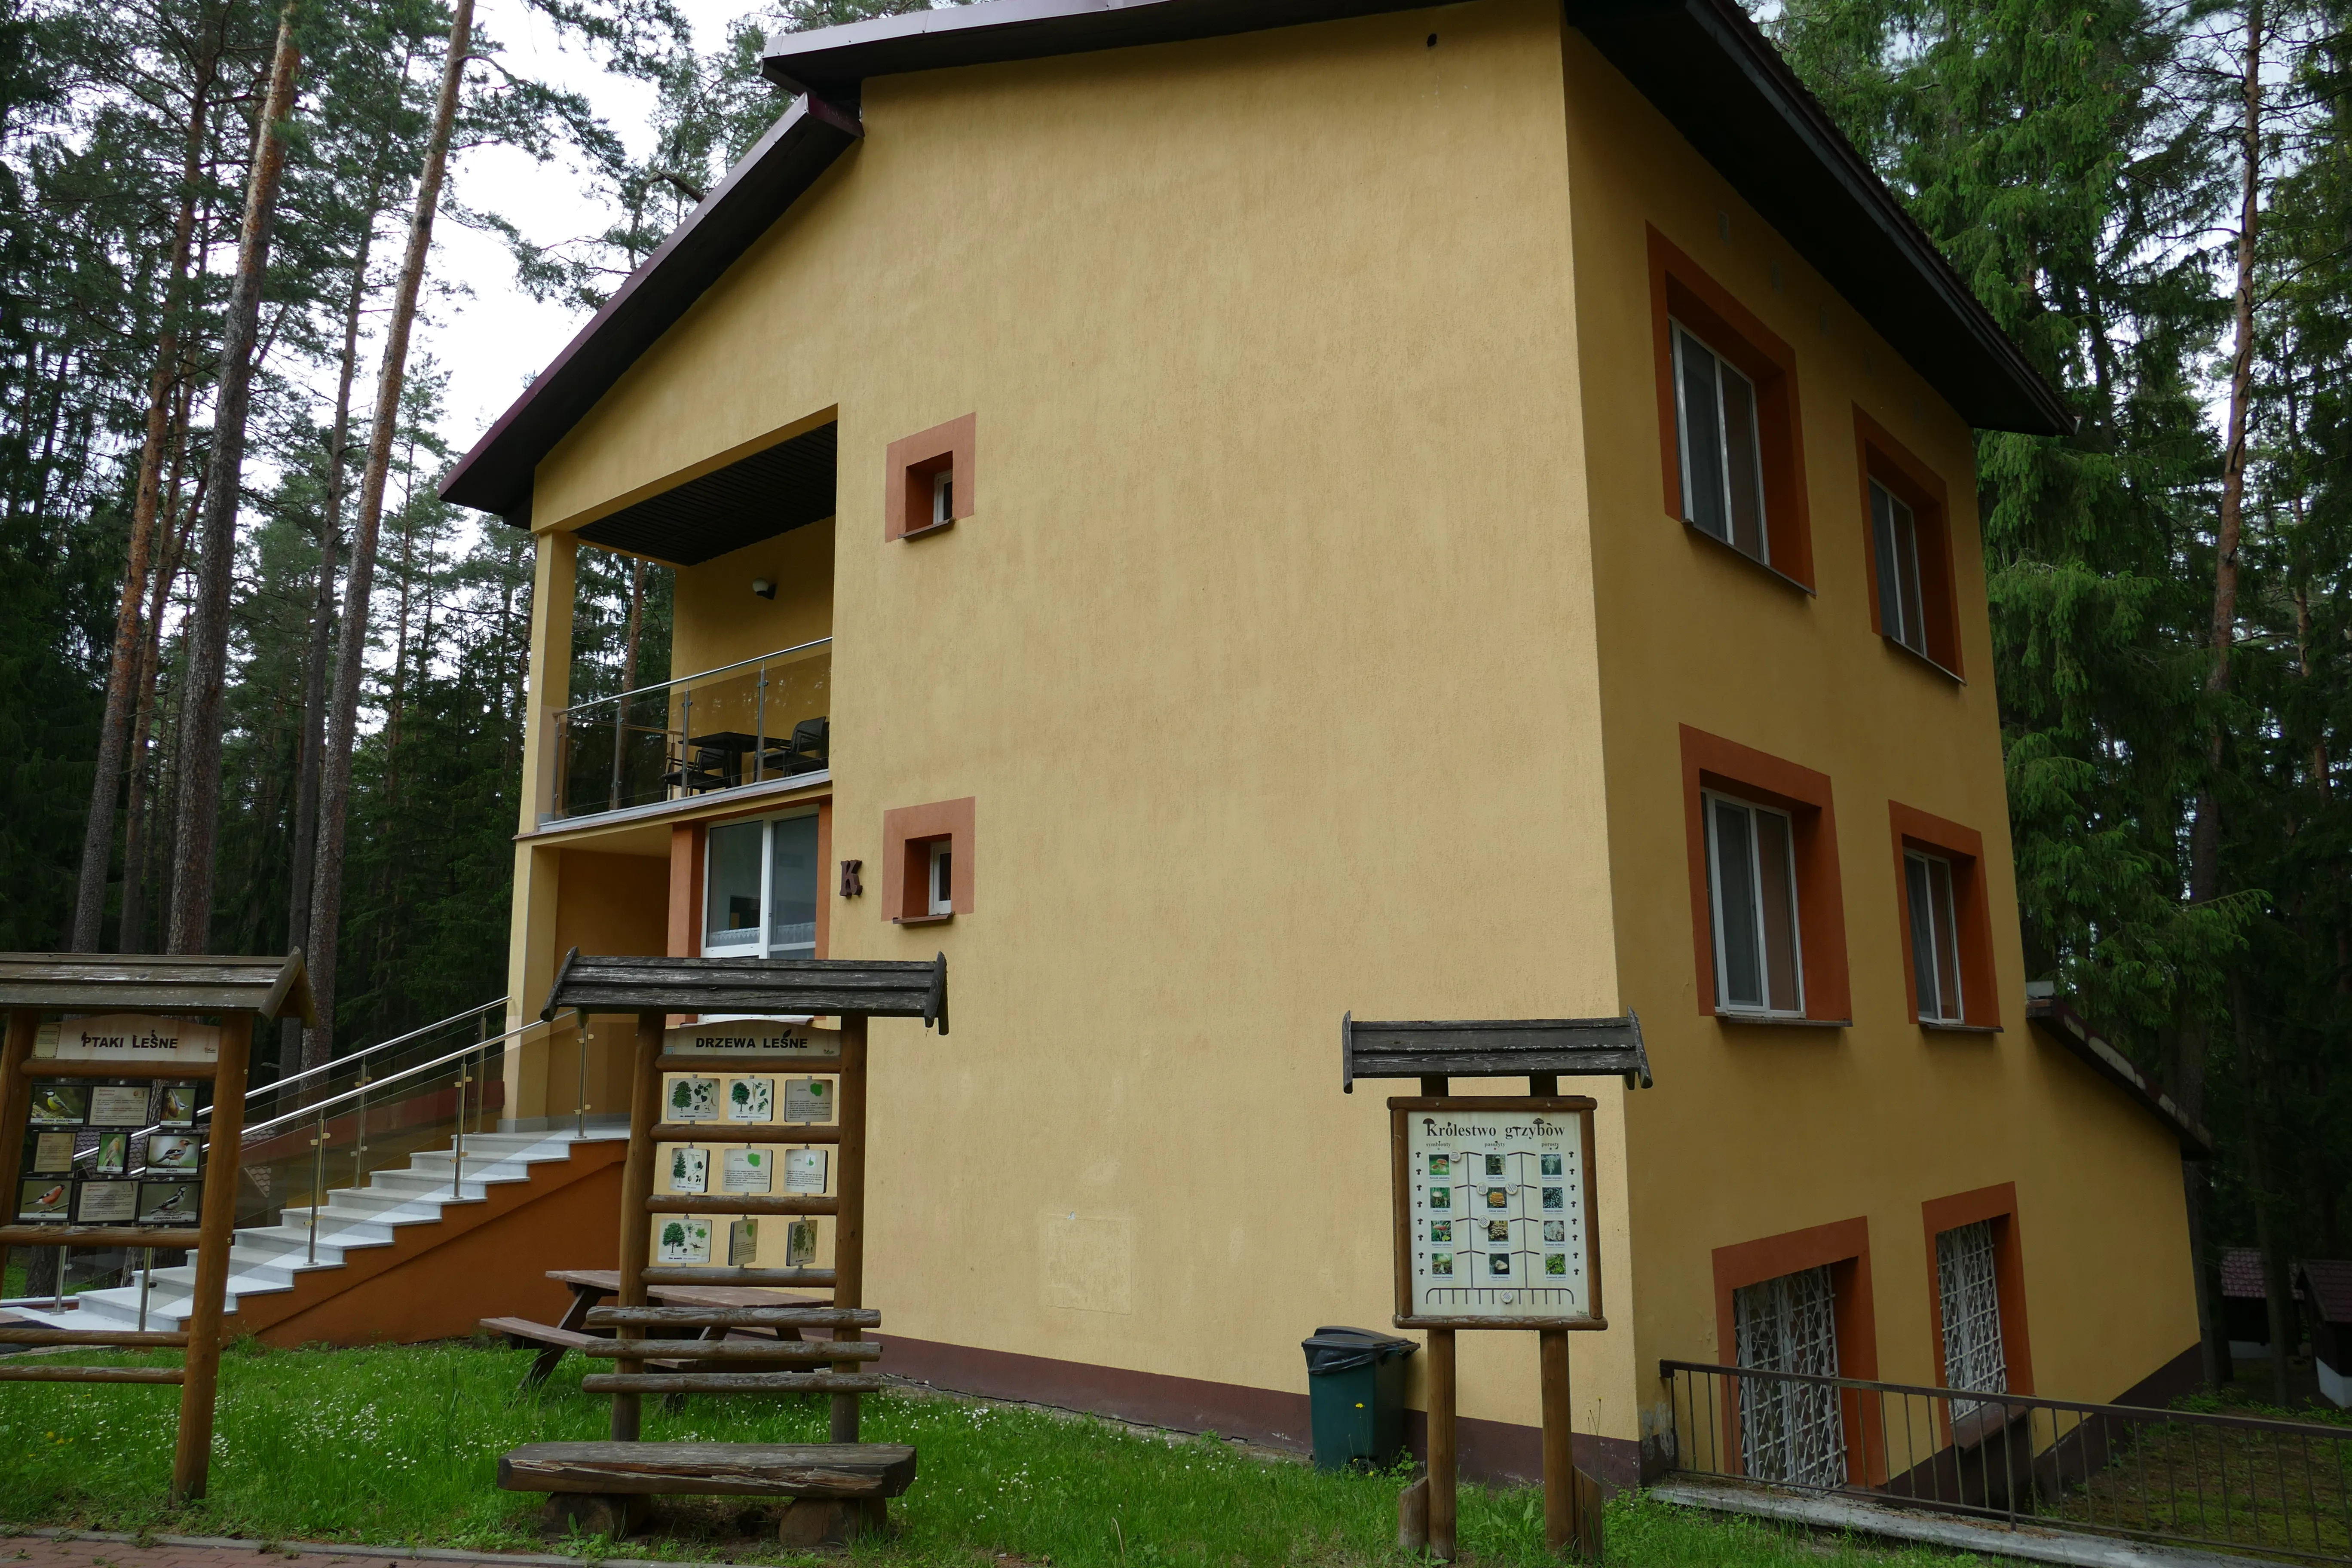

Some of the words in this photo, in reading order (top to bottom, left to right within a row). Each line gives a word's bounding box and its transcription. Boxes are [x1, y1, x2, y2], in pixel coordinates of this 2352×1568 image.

[839, 859, 863, 898] K
[81, 1033, 124, 1048] PTAKI
[696, 1037, 756, 1048] DRZEWA
[1425, 1121, 1497, 1137] Królestwo
[1505, 1121, 1565, 1140] grzybów
